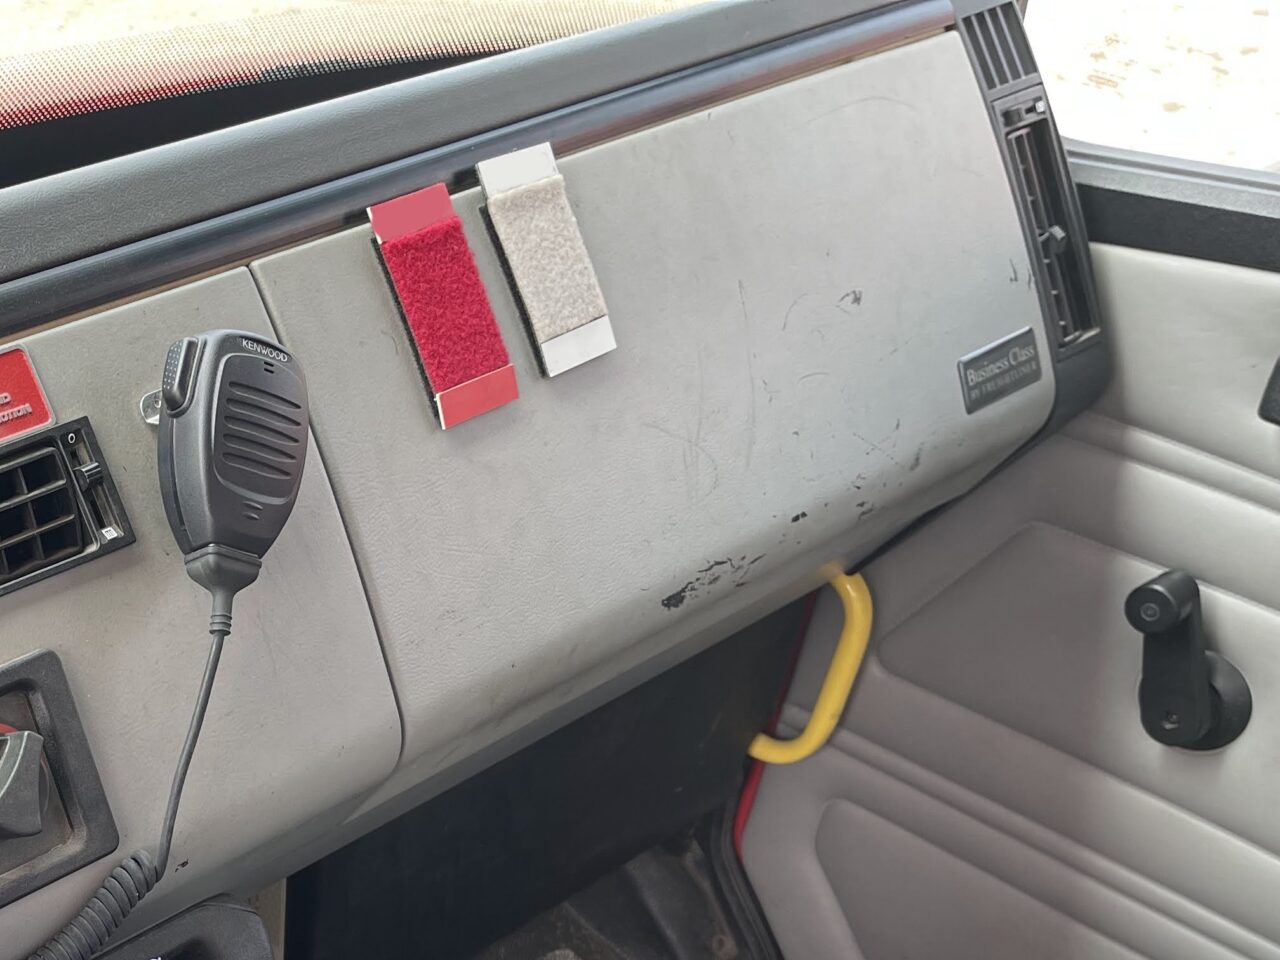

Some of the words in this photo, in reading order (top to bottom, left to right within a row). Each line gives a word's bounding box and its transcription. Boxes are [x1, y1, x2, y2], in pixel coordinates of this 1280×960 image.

[241, 338, 289, 362] KENWOOD
[966, 356, 1010, 387] Business
[1008, 344, 1036, 366] Class
